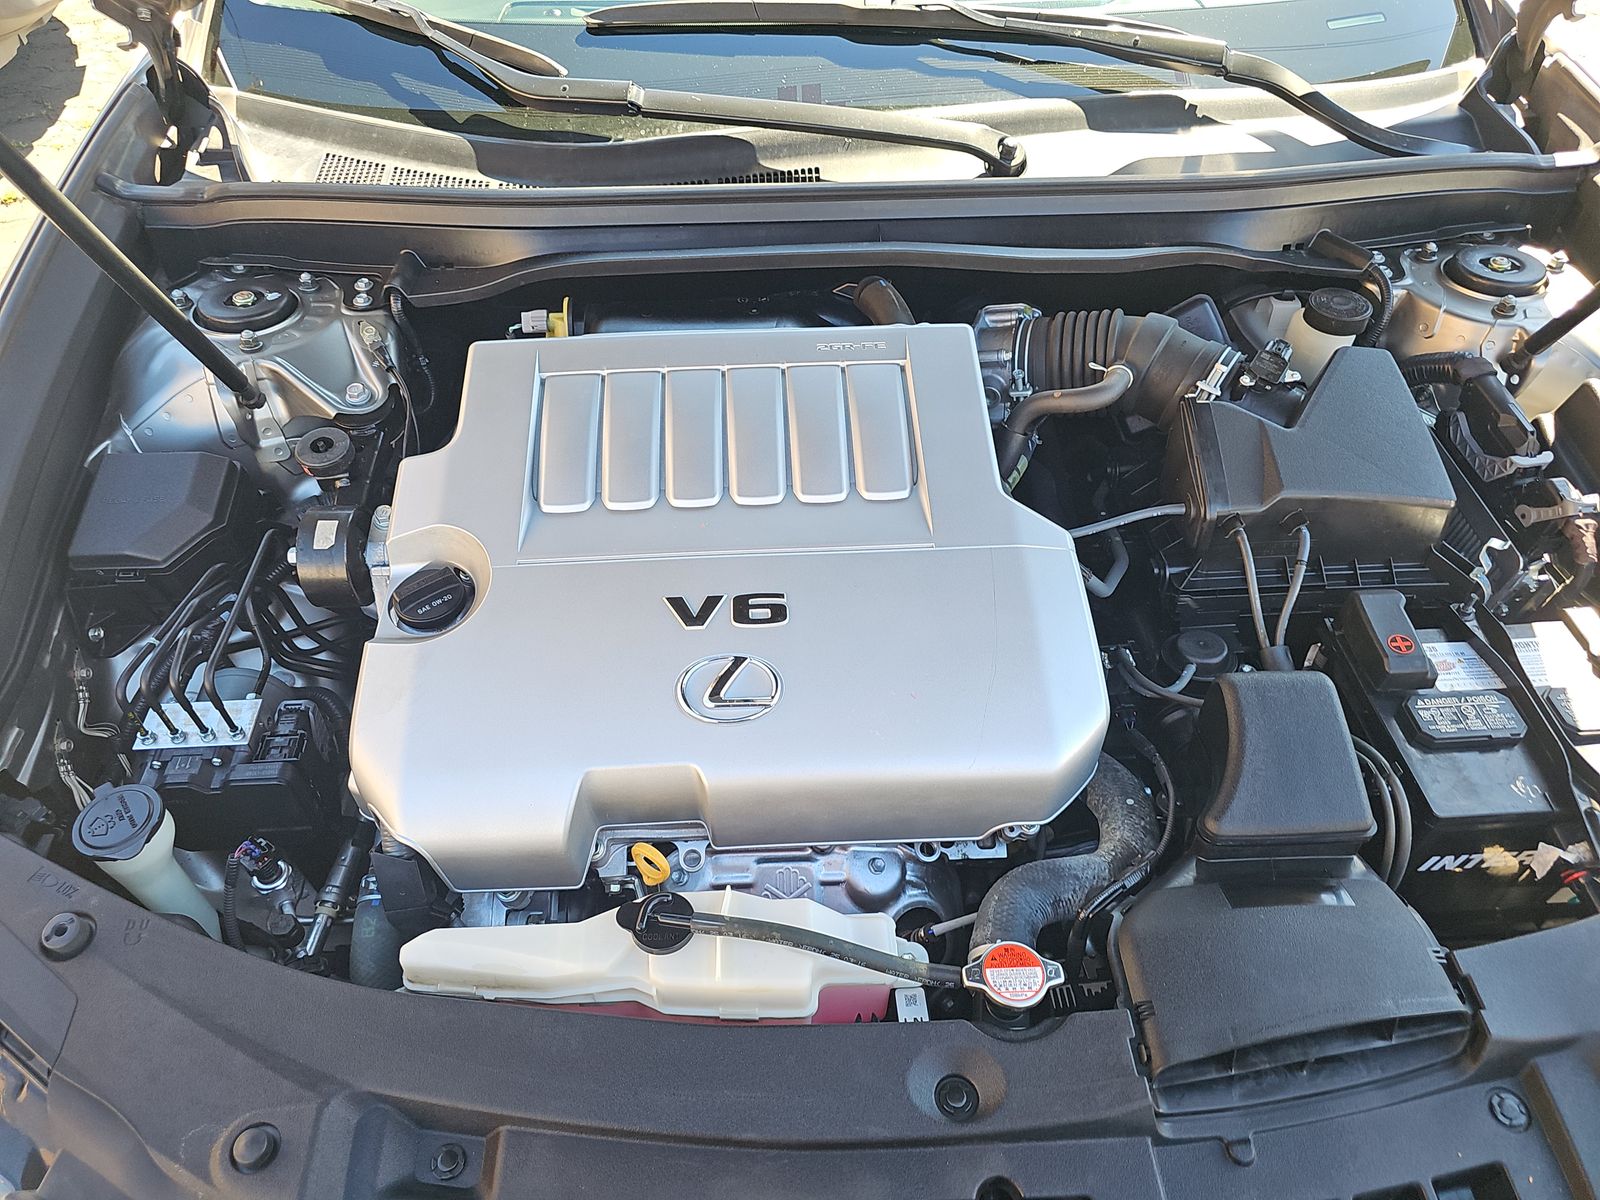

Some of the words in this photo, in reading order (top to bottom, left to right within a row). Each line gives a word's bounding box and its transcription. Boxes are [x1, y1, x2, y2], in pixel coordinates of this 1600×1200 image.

[816, 341, 887, 352] 2GR-FE
[417, 604, 430, 615] SAE
[662, 591, 790, 631] V6
[1424, 697, 1459, 706] DANGER
[1466, 695, 1498, 704] POISON
[642, 932, 680, 941] COOLANT
